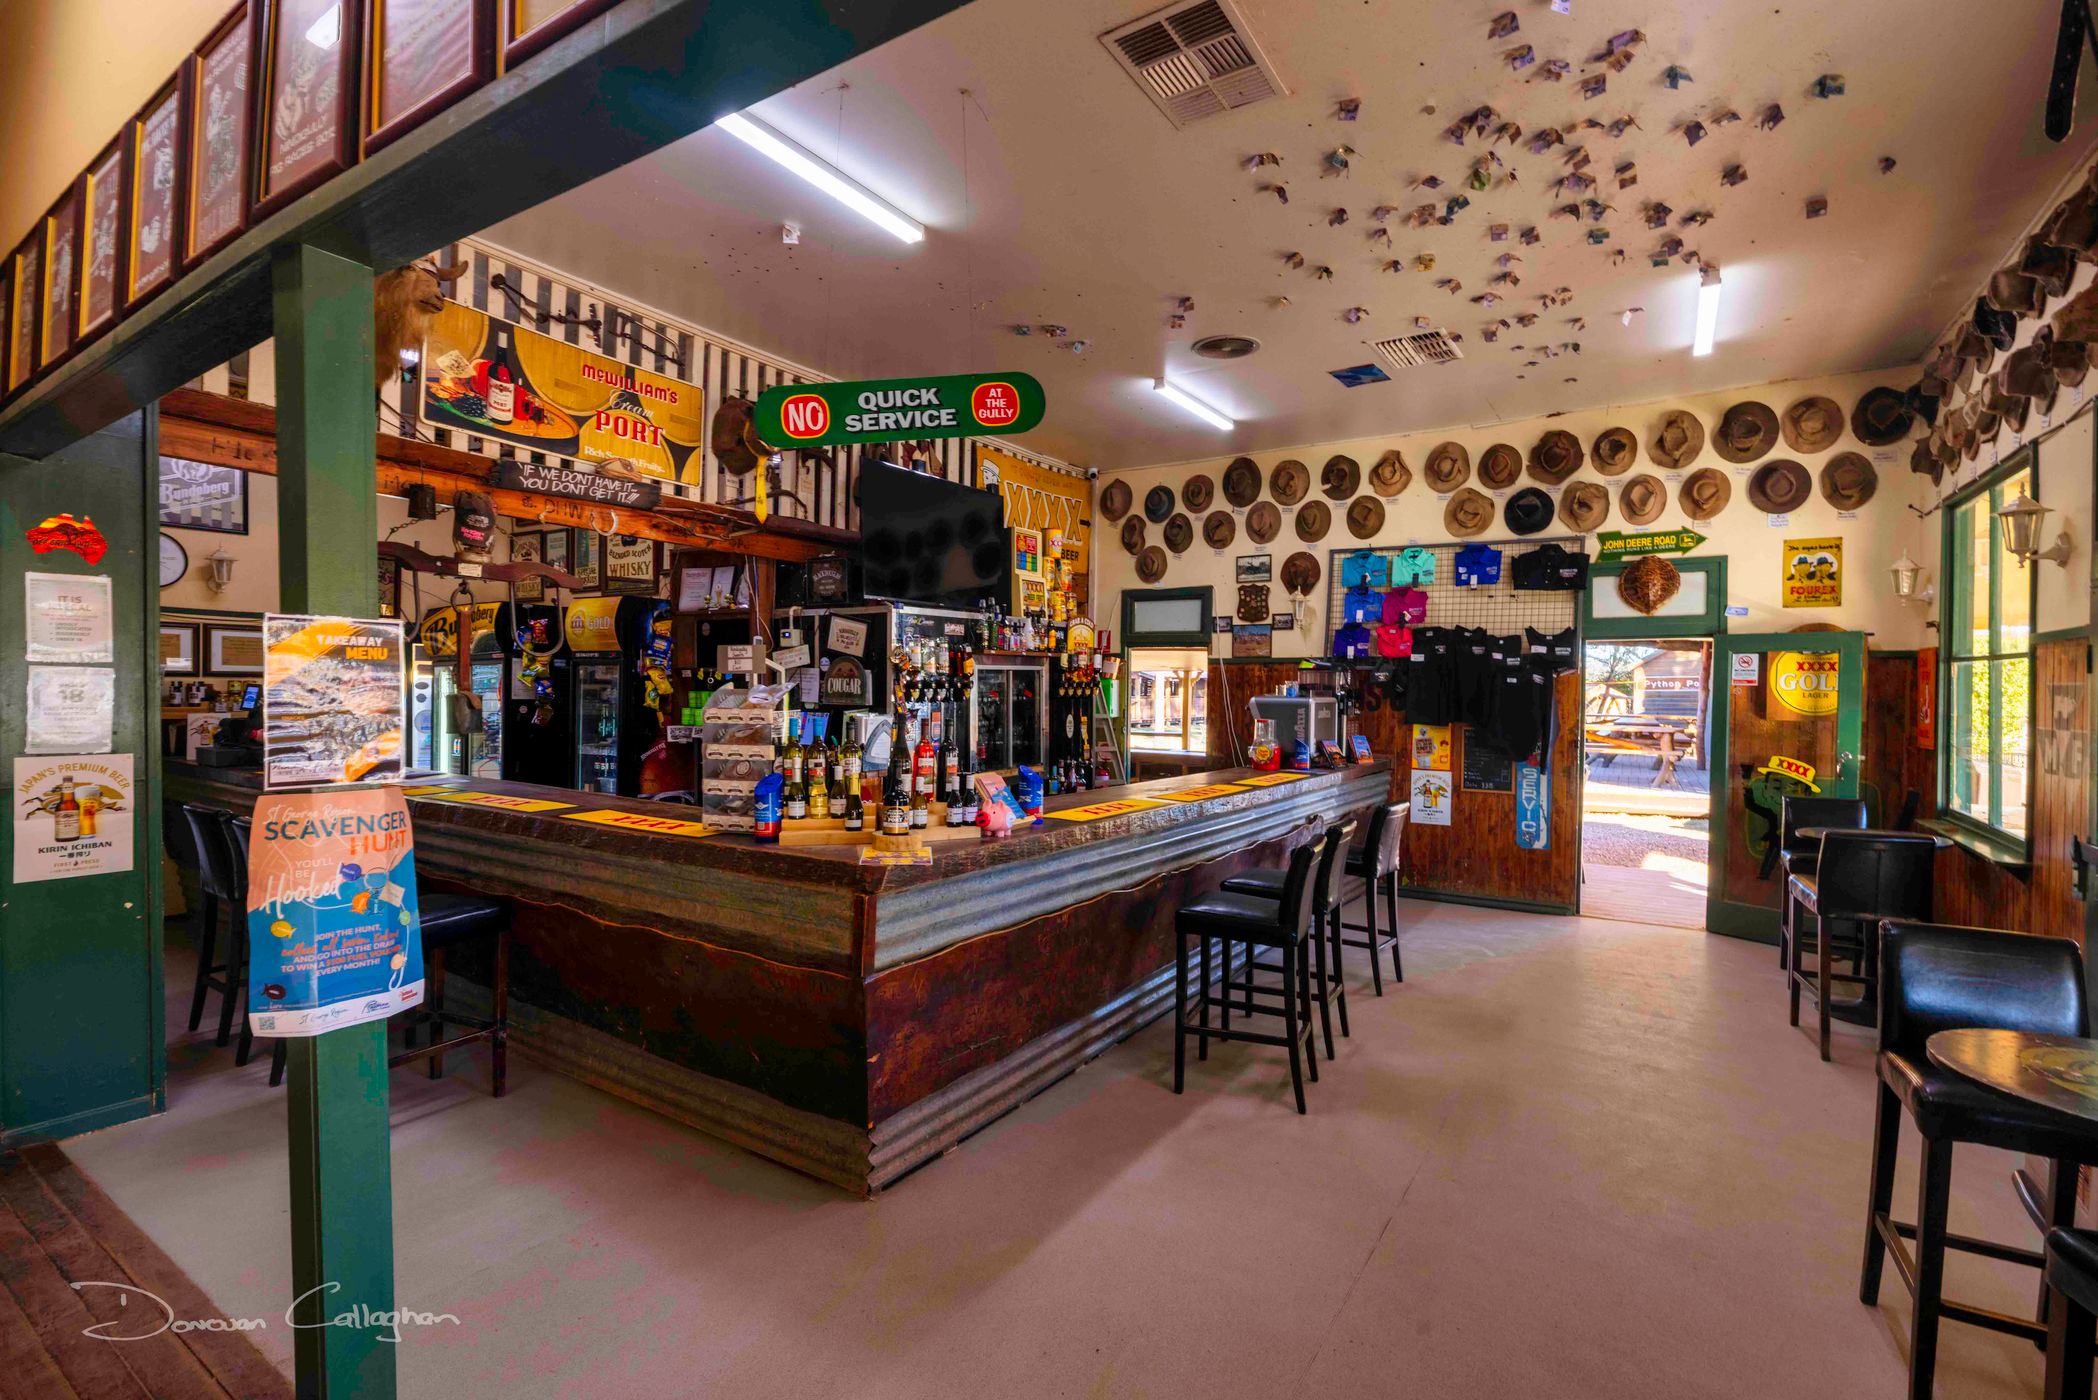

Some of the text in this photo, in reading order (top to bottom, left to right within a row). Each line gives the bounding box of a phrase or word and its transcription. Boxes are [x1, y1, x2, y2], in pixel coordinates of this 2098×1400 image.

[857, 387, 940, 413] QUICK
[988, 387, 1003, 398] AT
[610, 389, 654, 418] Cream
[985, 398, 1008, 408] THE
[788, 401, 825, 432] NO
[978, 407, 1014, 419] GULLY
[595, 409, 665, 448] PORT
[844, 409, 958, 433] SERVICE
[584, 446, 605, 459] Rich
[539, 467, 560, 480] WE
[561, 471, 595, 485] DONT
[595, 477, 622, 491] HAVE
[519, 476, 548, 490] YOU
[552, 481, 587, 496] DONT
[589, 486, 615, 500] GET
[1004, 480, 1082, 546] XXXX
[1603, 535, 1677, 550] JOHN DEERE ROAD
[631, 543, 652, 558] SCOTCH
[1061, 549, 1080, 563] BEER
[609, 561, 652, 578] WHISKY
[1790, 584, 1836, 595] FOUREX
[57, 595, 82, 604] IT IS
[586, 615, 611, 630] GOLD
[316, 634, 384, 647] TAKEAWAY
[345, 647, 388, 660] MENU
[1796, 661, 1838, 672] XXXX
[827, 677, 862, 695] COUGAR
[1645, 679, 1681, 689] Python
[1780, 672, 1838, 691] GOL
[58, 688, 86, 703] 18
[1779, 758, 1811, 778] XXXX
[18, 763, 131, 794] JAPAN'S PREMIUM BEER
[264, 810, 407, 841] SCAVENGER
[38, 841, 112, 854] KIRIN ICHIBAN
[350, 829, 407, 856] HUNT
[295, 857, 334, 869] YOU'LL
[295, 869, 311, 879] BE
[259, 862, 343, 919] Hooked
[315, 932, 335, 941] JOIN
[293, 939, 396, 964] AND GO INTO THE DRAW
[281, 964, 295, 973] TO
[296, 963, 317, 971] WIN
[315, 958, 381, 977] EVERY MONTH!
